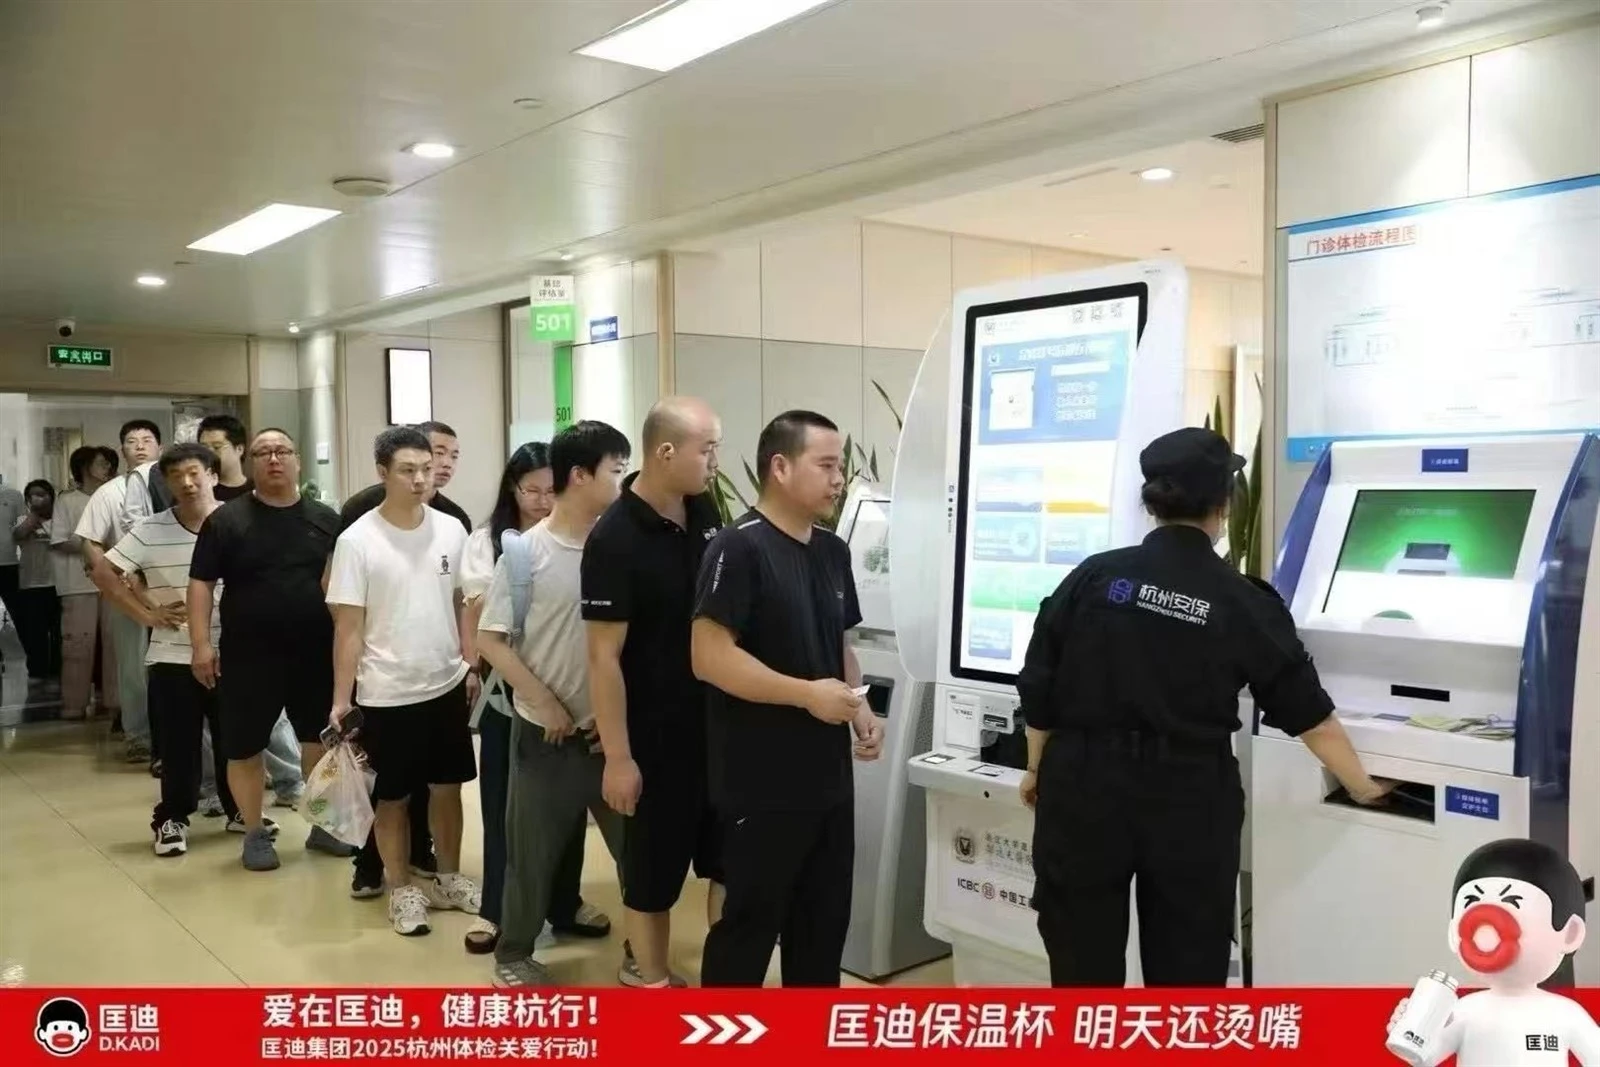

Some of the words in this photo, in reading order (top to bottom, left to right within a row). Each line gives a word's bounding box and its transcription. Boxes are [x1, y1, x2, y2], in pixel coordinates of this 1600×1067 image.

[535, 313, 571, 332] 501
[556, 406, 571, 422] 501
[1138, 584, 1210, 618] 杭州安保
[1136, 600, 1173, 616] HANGZHOU
[1172, 610, 1207, 626] SECURITY
[957, 877, 980, 893] ICBC
[999, 889, 1033, 907] 中国工
